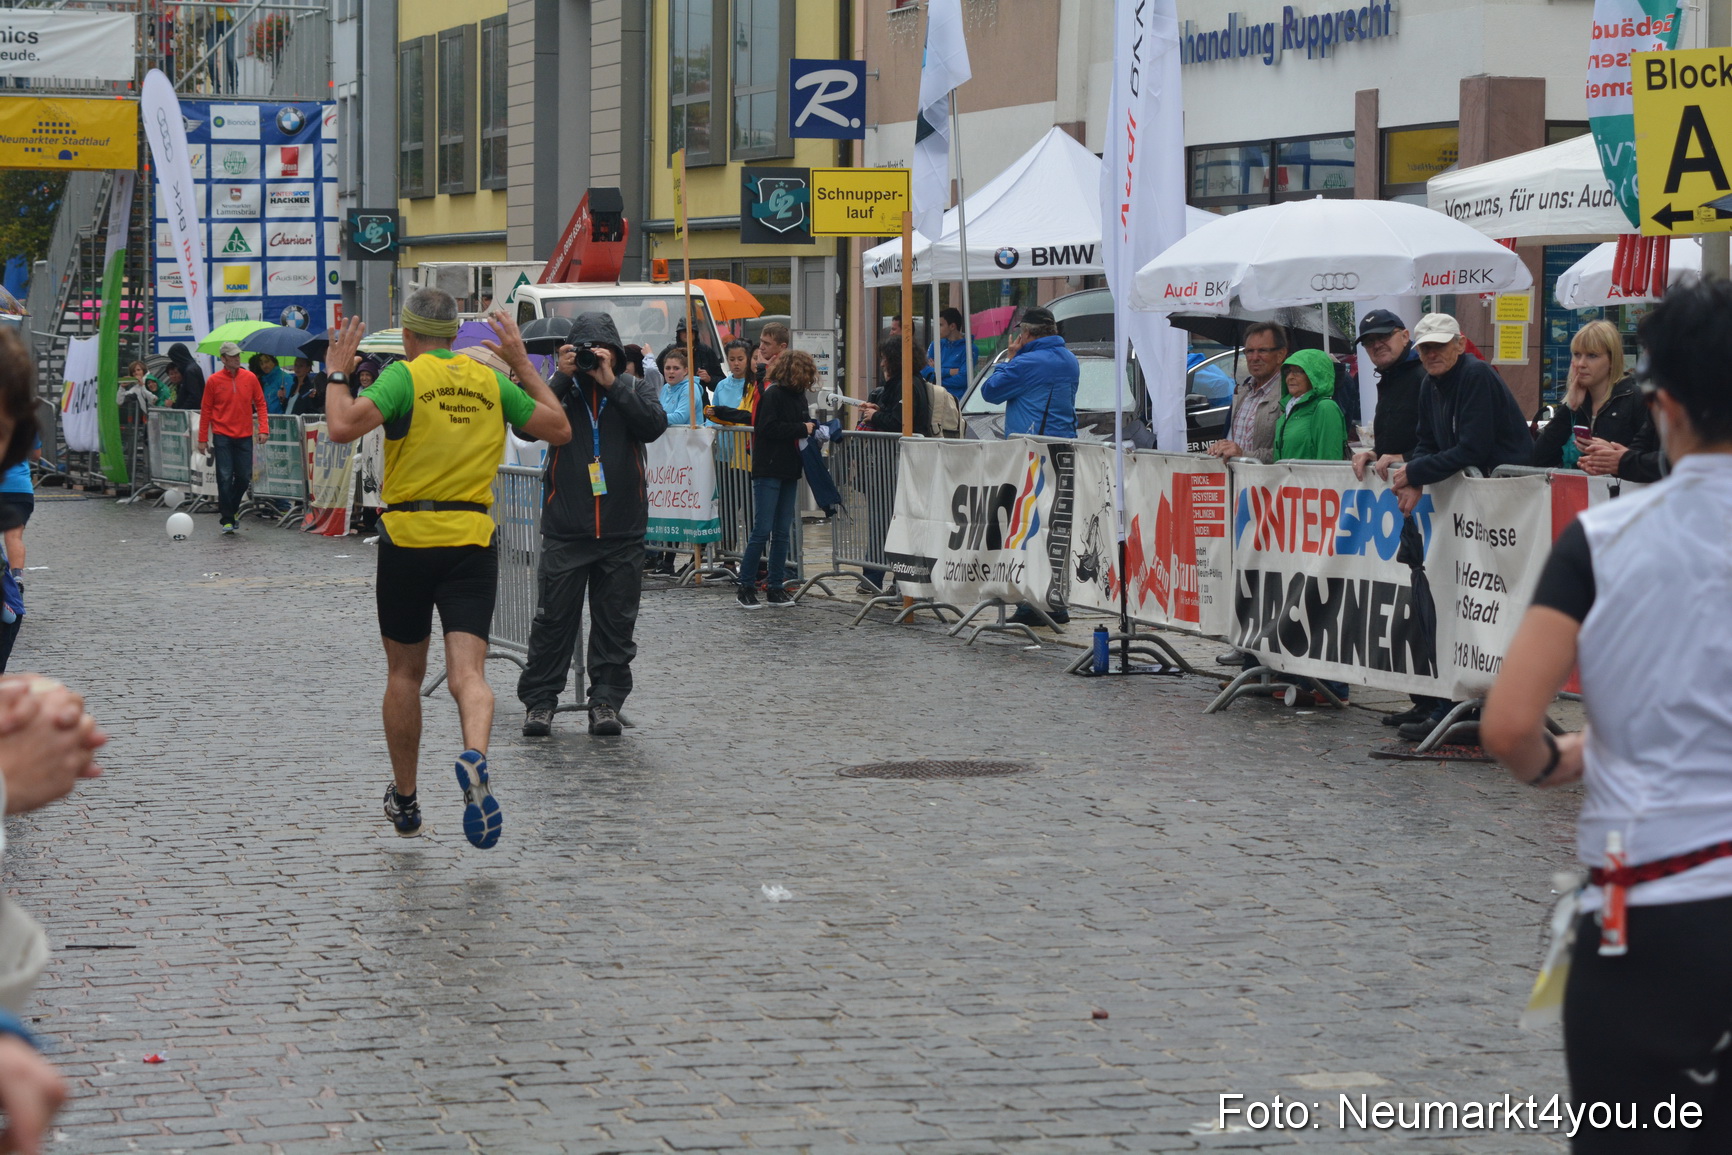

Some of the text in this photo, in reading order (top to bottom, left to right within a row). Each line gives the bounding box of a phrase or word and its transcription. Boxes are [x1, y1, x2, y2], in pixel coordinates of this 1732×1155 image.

[1180, 0, 1390, 65] handlung Rupprecht
[1645, 55, 1732, 90] Block
[0, 135, 110, 146] Neumarkter Stadtlauf
[1663, 104, 1731, 194] A
[817, 187, 903, 203] Schnupper-
[1474, 196, 1504, 218] uns,
[1509, 187, 1535, 212] für
[1538, 189, 1575, 210] uns:
[846, 205, 874, 219] lauf
[1031, 244, 1094, 266] BMW
[1164, 281, 1198, 298] Audi
[1422, 269, 1495, 288] Audi BKK
[419, 387, 495, 411] TSV 1883 Allersberg
[439, 401, 480, 413] Marathon-
[449, 414, 471, 424] Team
[1251, 485, 1435, 561] INTERSPOT
[1462, 594, 1500, 625] Stadt
[1235, 569, 1433, 677] HACKNER
